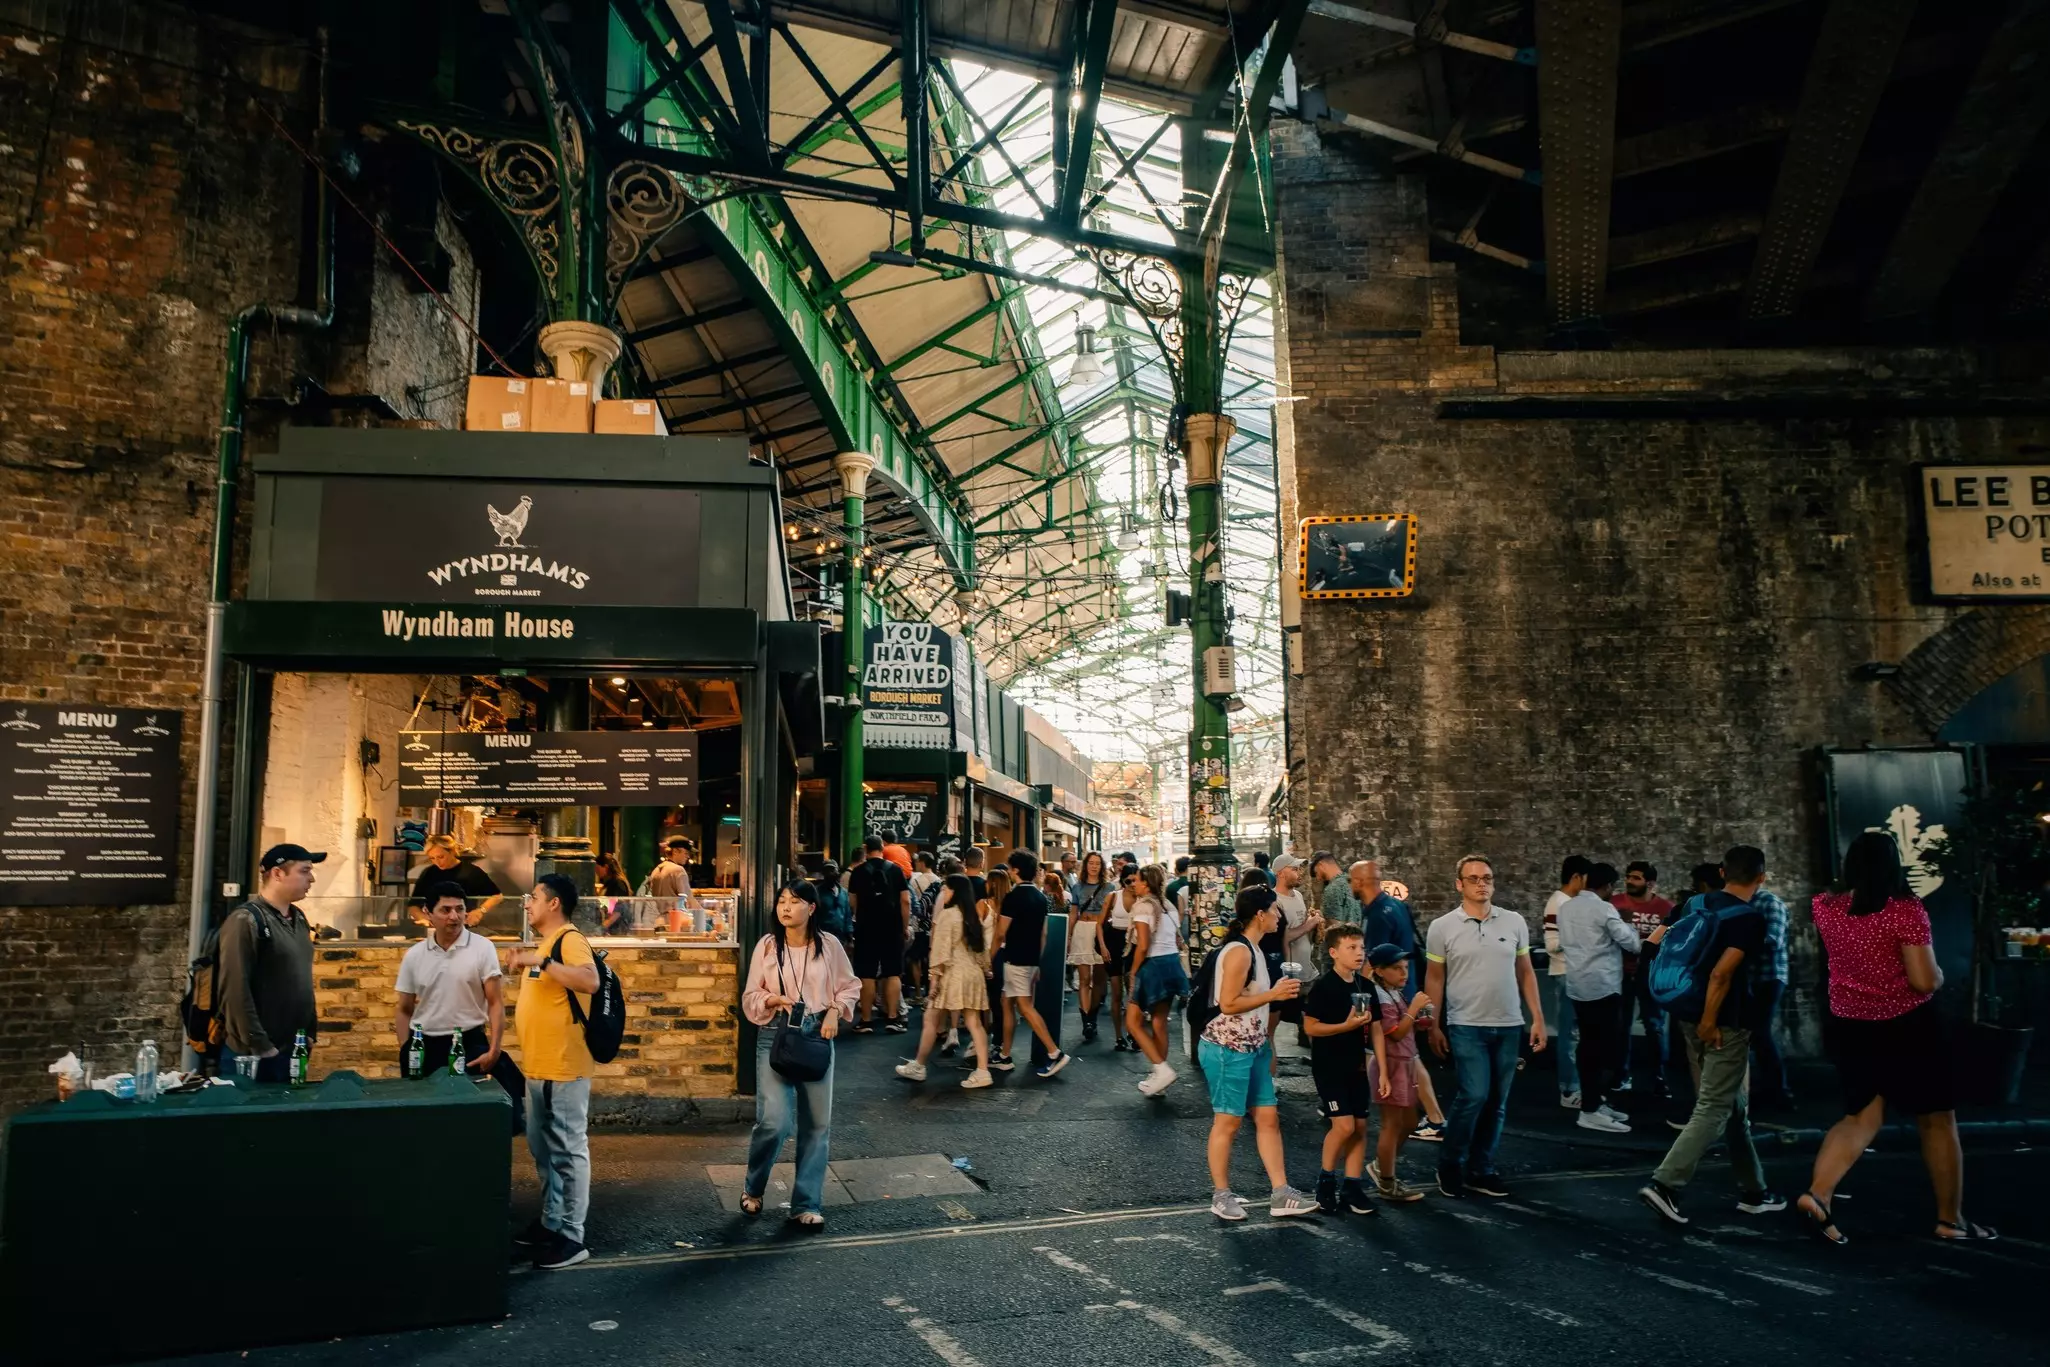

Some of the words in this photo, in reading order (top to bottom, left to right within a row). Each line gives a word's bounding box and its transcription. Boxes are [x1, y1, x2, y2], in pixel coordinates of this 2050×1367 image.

[1931, 476, 2009, 507] LEE
[427, 553, 590, 590] WYNDHAM'S
[1972, 572, 2013, 587] Also
[2020, 573, 2041, 586] at
[474, 588, 511, 596] BOROUGH
[511, 589, 541, 597] MARKET
[382, 610, 495, 641] Wyndham
[504, 611, 575, 639] House
[885, 625, 928, 642] YOU
[877, 646, 936, 663] HAVE
[867, 667, 948, 684] ARRIVED
[869, 691, 908, 703] BOROUGH
[909, 692, 942, 705] MARKET
[57, 711, 118, 728] MENU
[869, 711, 917, 722] NORTHFIELD
[919, 713, 941, 723] FARM
[485, 735, 532, 748] MENU
[865, 799, 893, 811] SALT
[893, 800, 927, 814] BEEF
[864, 810, 903, 822] Sandwich
[1328, 1100, 1339, 1112] LB
